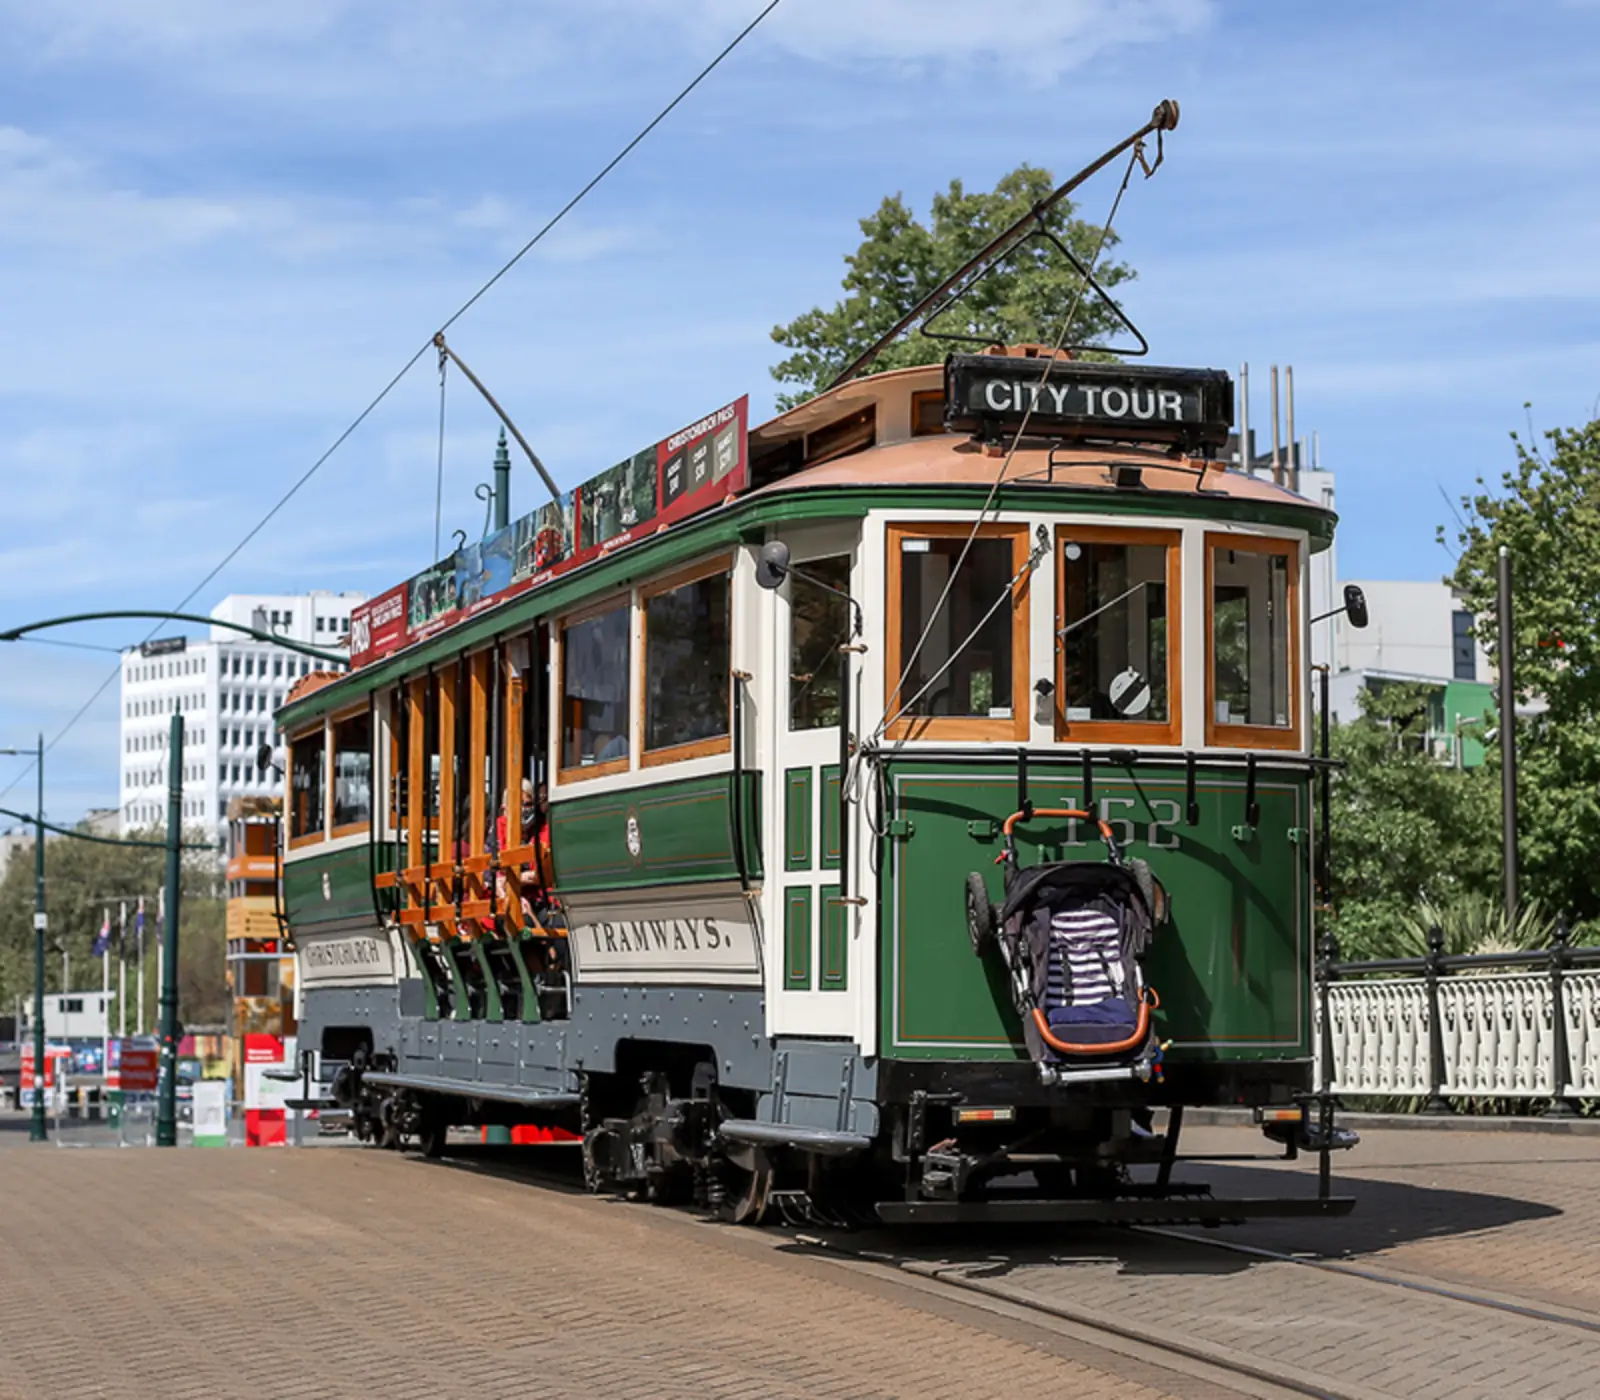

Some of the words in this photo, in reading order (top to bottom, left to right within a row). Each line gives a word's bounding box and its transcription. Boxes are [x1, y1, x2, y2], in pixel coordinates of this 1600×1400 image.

[986, 380, 1069, 414] CITY
[1078, 386, 1183, 420] TOUR
[668, 414, 716, 452] CHRISTCHURCH
[717, 404, 735, 425] PASS
[1060, 797, 1181, 848] 152
[307, 939, 381, 968] CHRISTCHURCH
[589, 916, 731, 952] TRAMWAYS.
